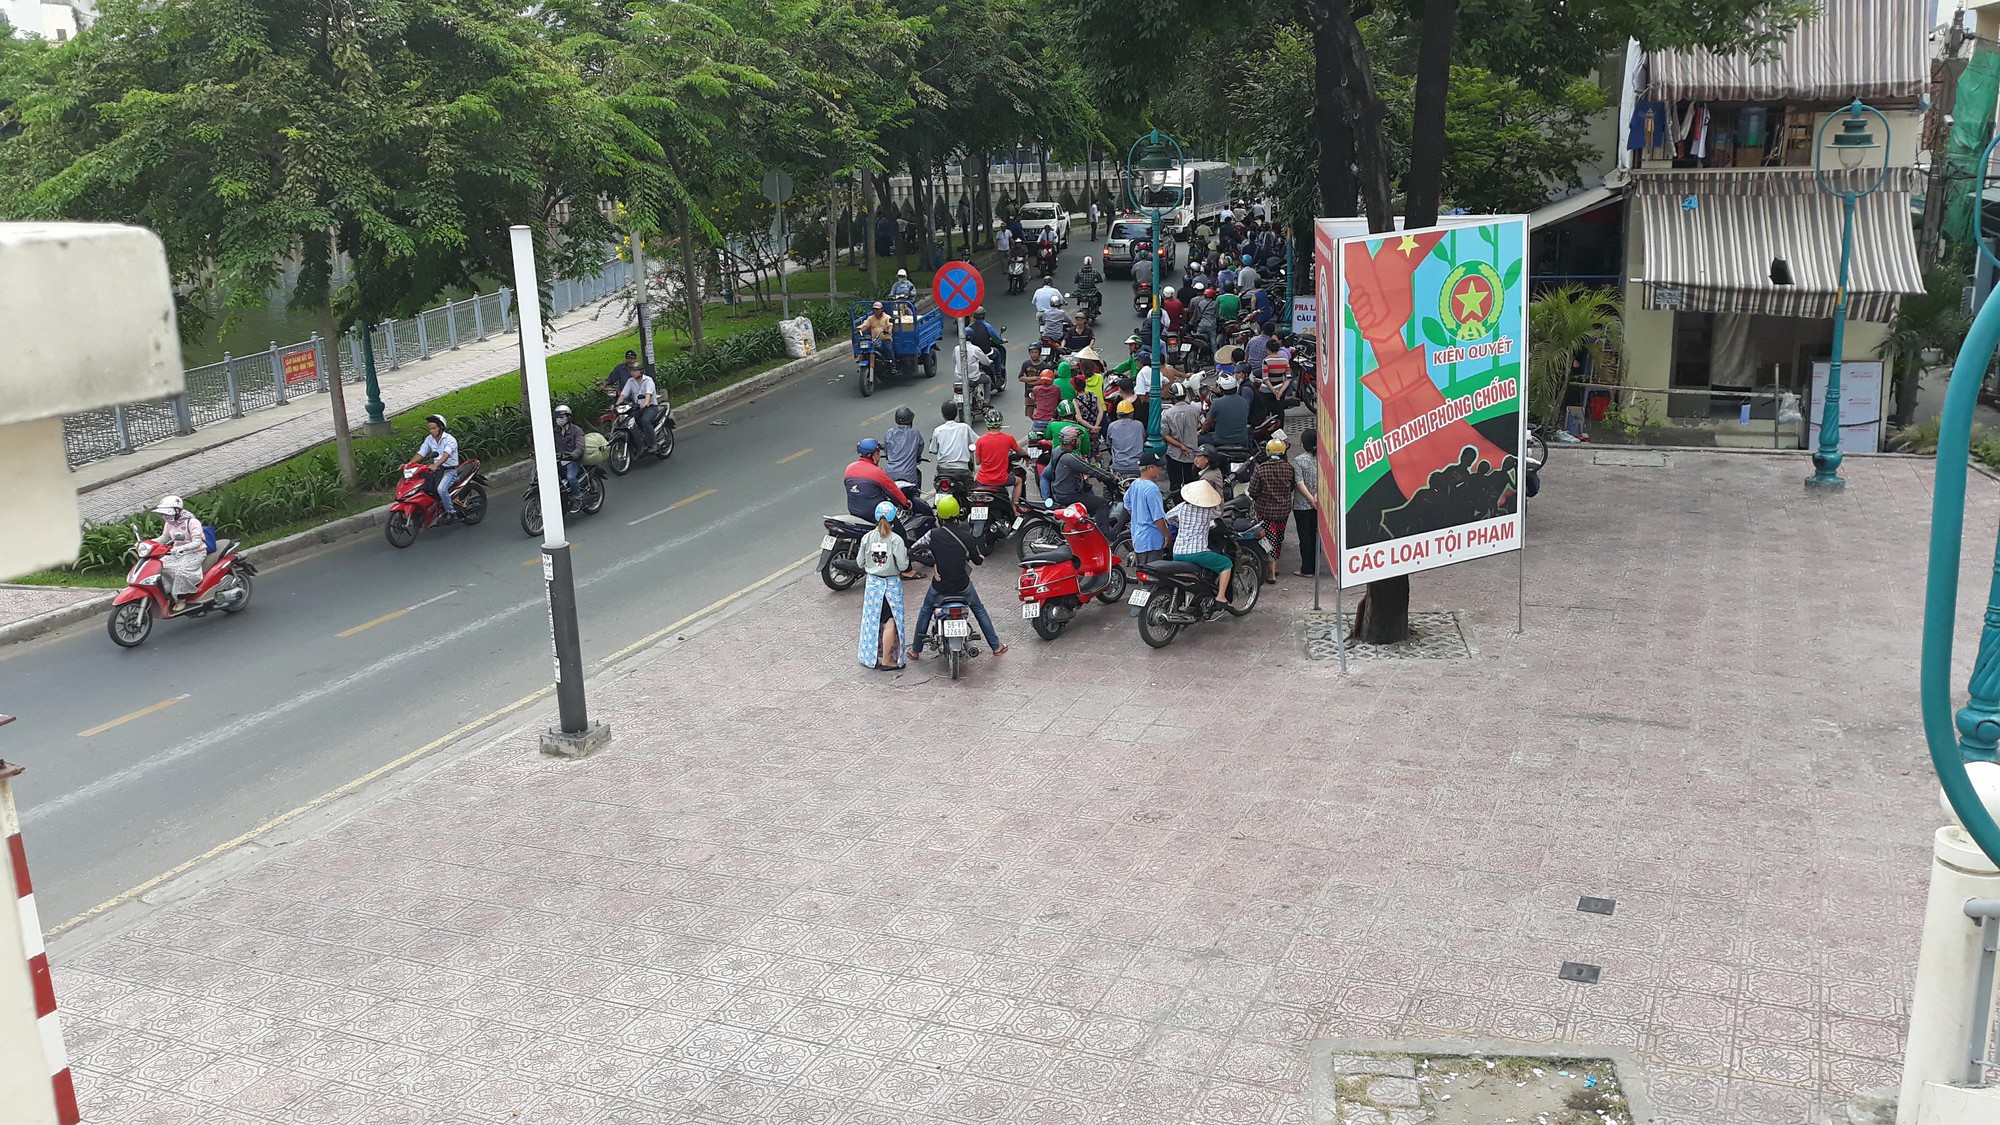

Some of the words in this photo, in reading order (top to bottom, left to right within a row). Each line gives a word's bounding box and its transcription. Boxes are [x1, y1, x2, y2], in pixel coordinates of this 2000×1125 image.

[1433, 346, 1465, 365] KIÊN
[1468, 335, 1513, 359] QUYẾT
[1355, 437, 1384, 472] ĐẤU
[1384, 416, 1428, 454] TRANH
[1428, 396, 1472, 431] PHÒNG
[1474, 377, 1517, 409] CHỐNG
[1348, 547, 1385, 574] CÁC
[1390, 540, 1429, 565] LOẠI
[1435, 529, 1462, 558] TỘI
[1467, 521, 1514, 548] PHẠM
